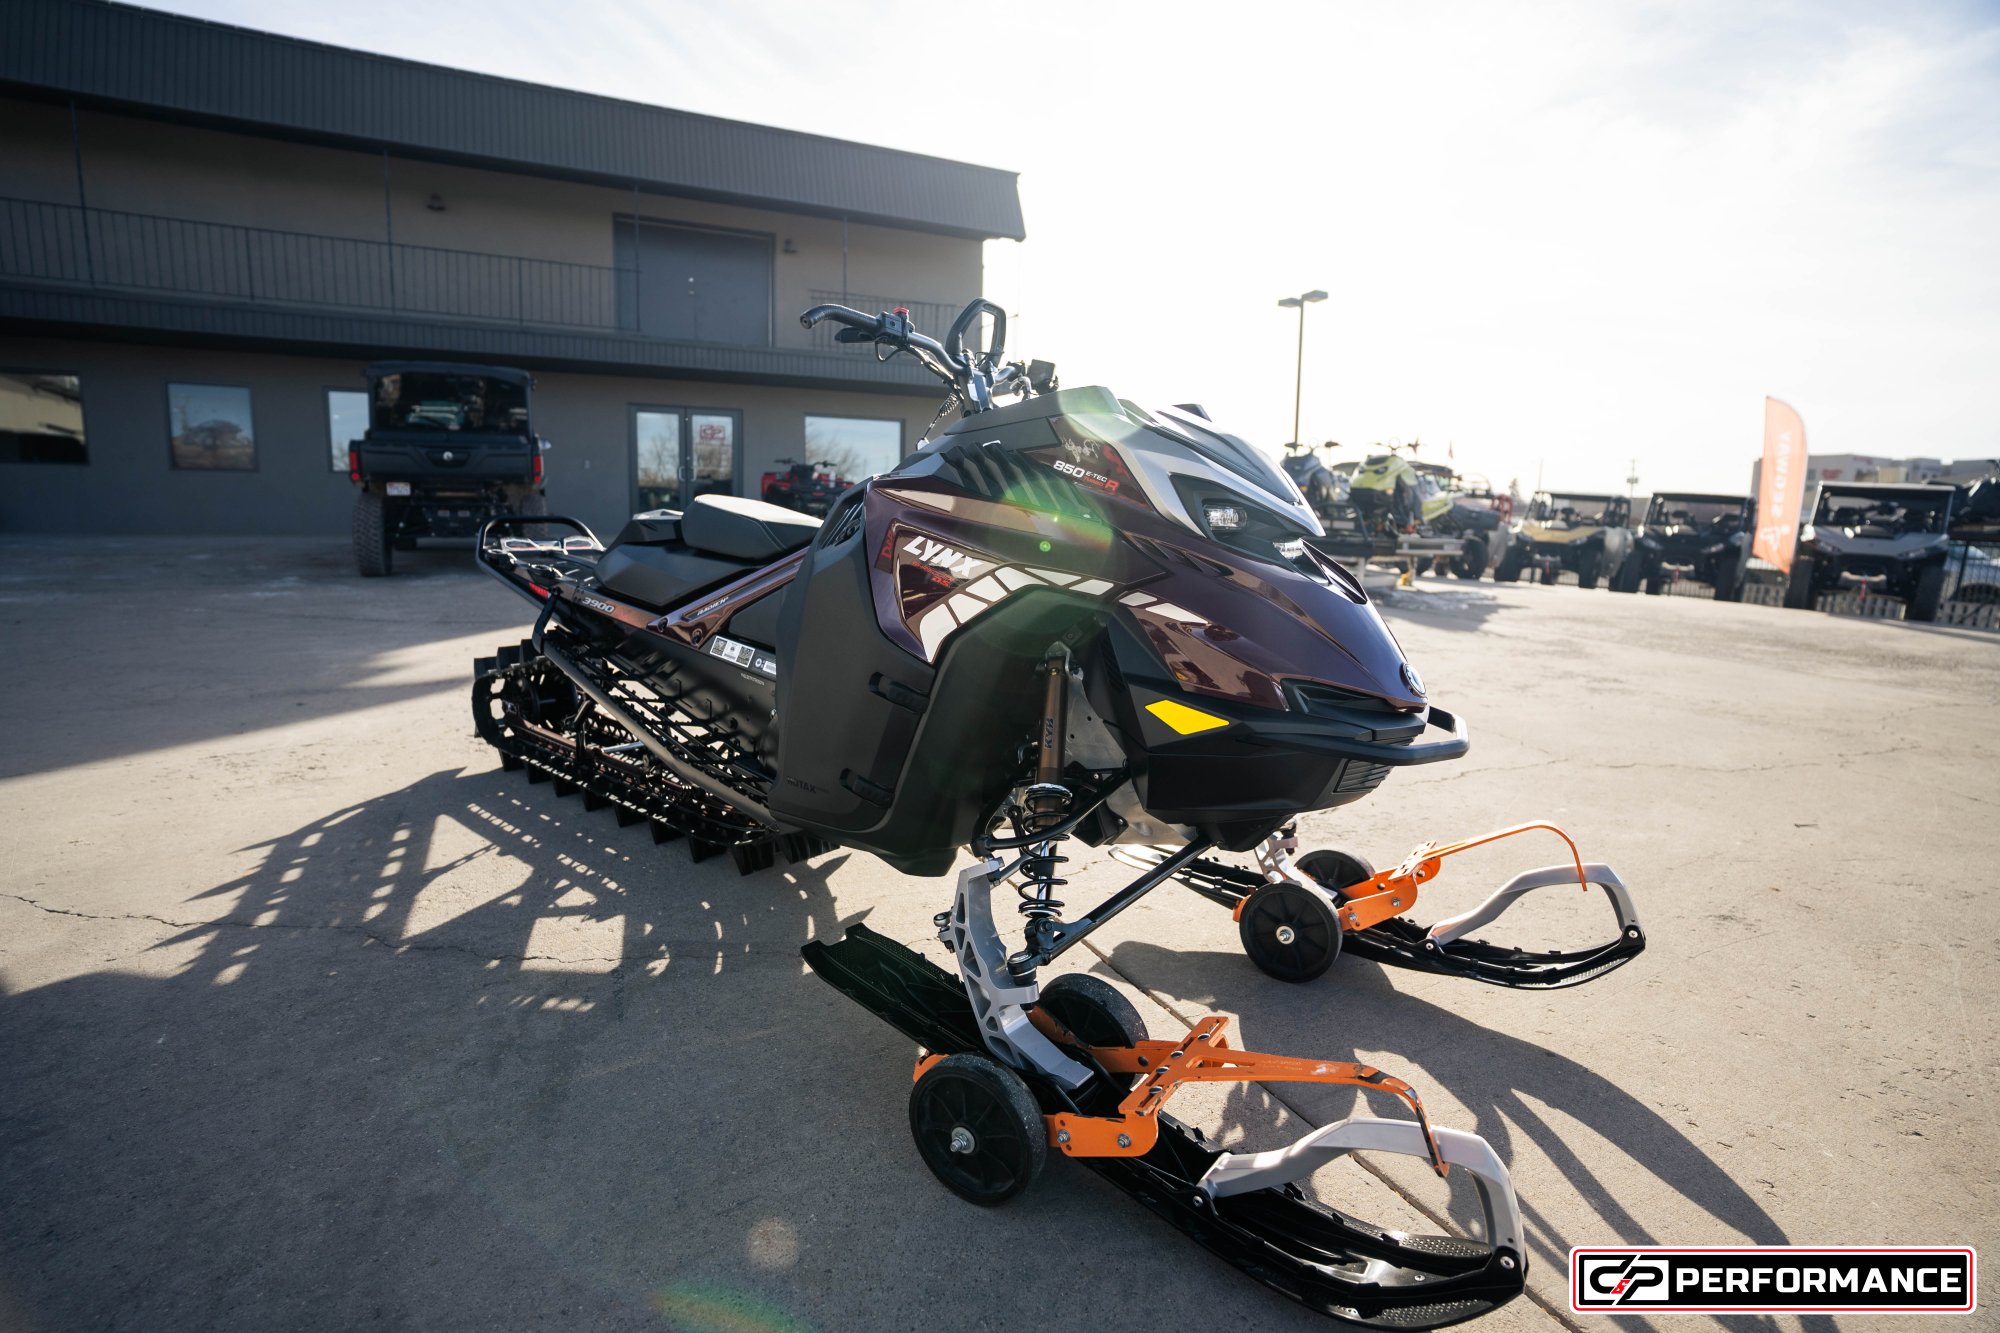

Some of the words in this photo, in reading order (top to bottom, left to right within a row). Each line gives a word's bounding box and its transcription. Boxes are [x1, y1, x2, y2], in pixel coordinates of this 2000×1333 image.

[1053, 460, 1085, 478] 850
[1086, 471, 1108, 483] E-TEC
[903, 536, 984, 577] LYNX
[582, 597, 614, 613] 3900
